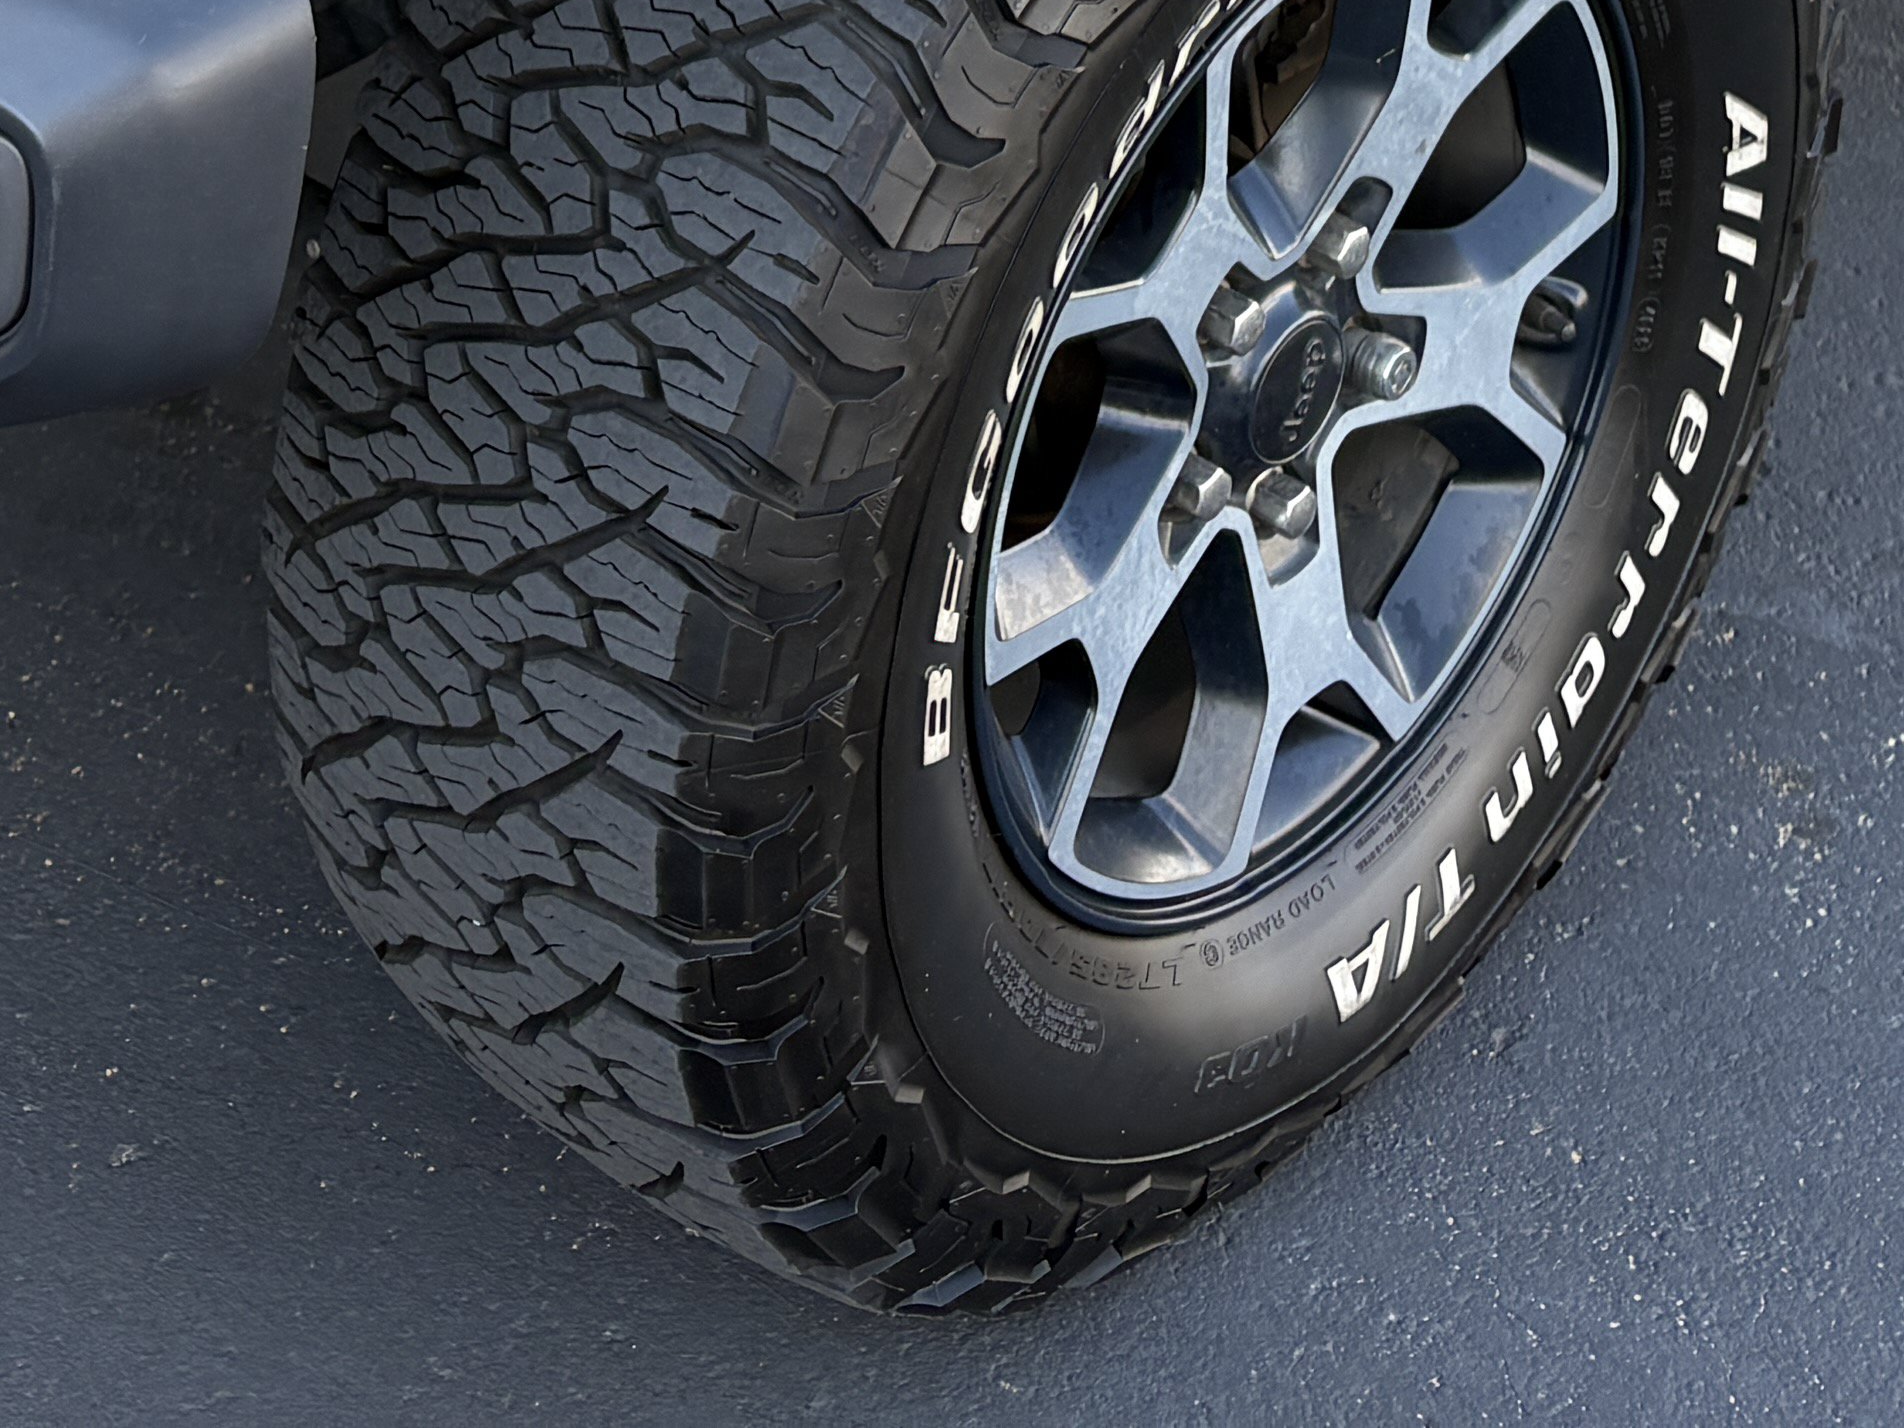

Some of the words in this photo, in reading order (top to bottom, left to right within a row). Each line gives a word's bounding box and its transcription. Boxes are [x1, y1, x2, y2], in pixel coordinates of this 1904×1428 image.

[1279, 337, 1327, 443] Jeep
[1480, 90, 1770, 845] All-Terrain
[1228, 910, 1285, 957] RANGE
[1292, 873, 1338, 919] LOAD
[1325, 848, 1476, 1024] T/A
